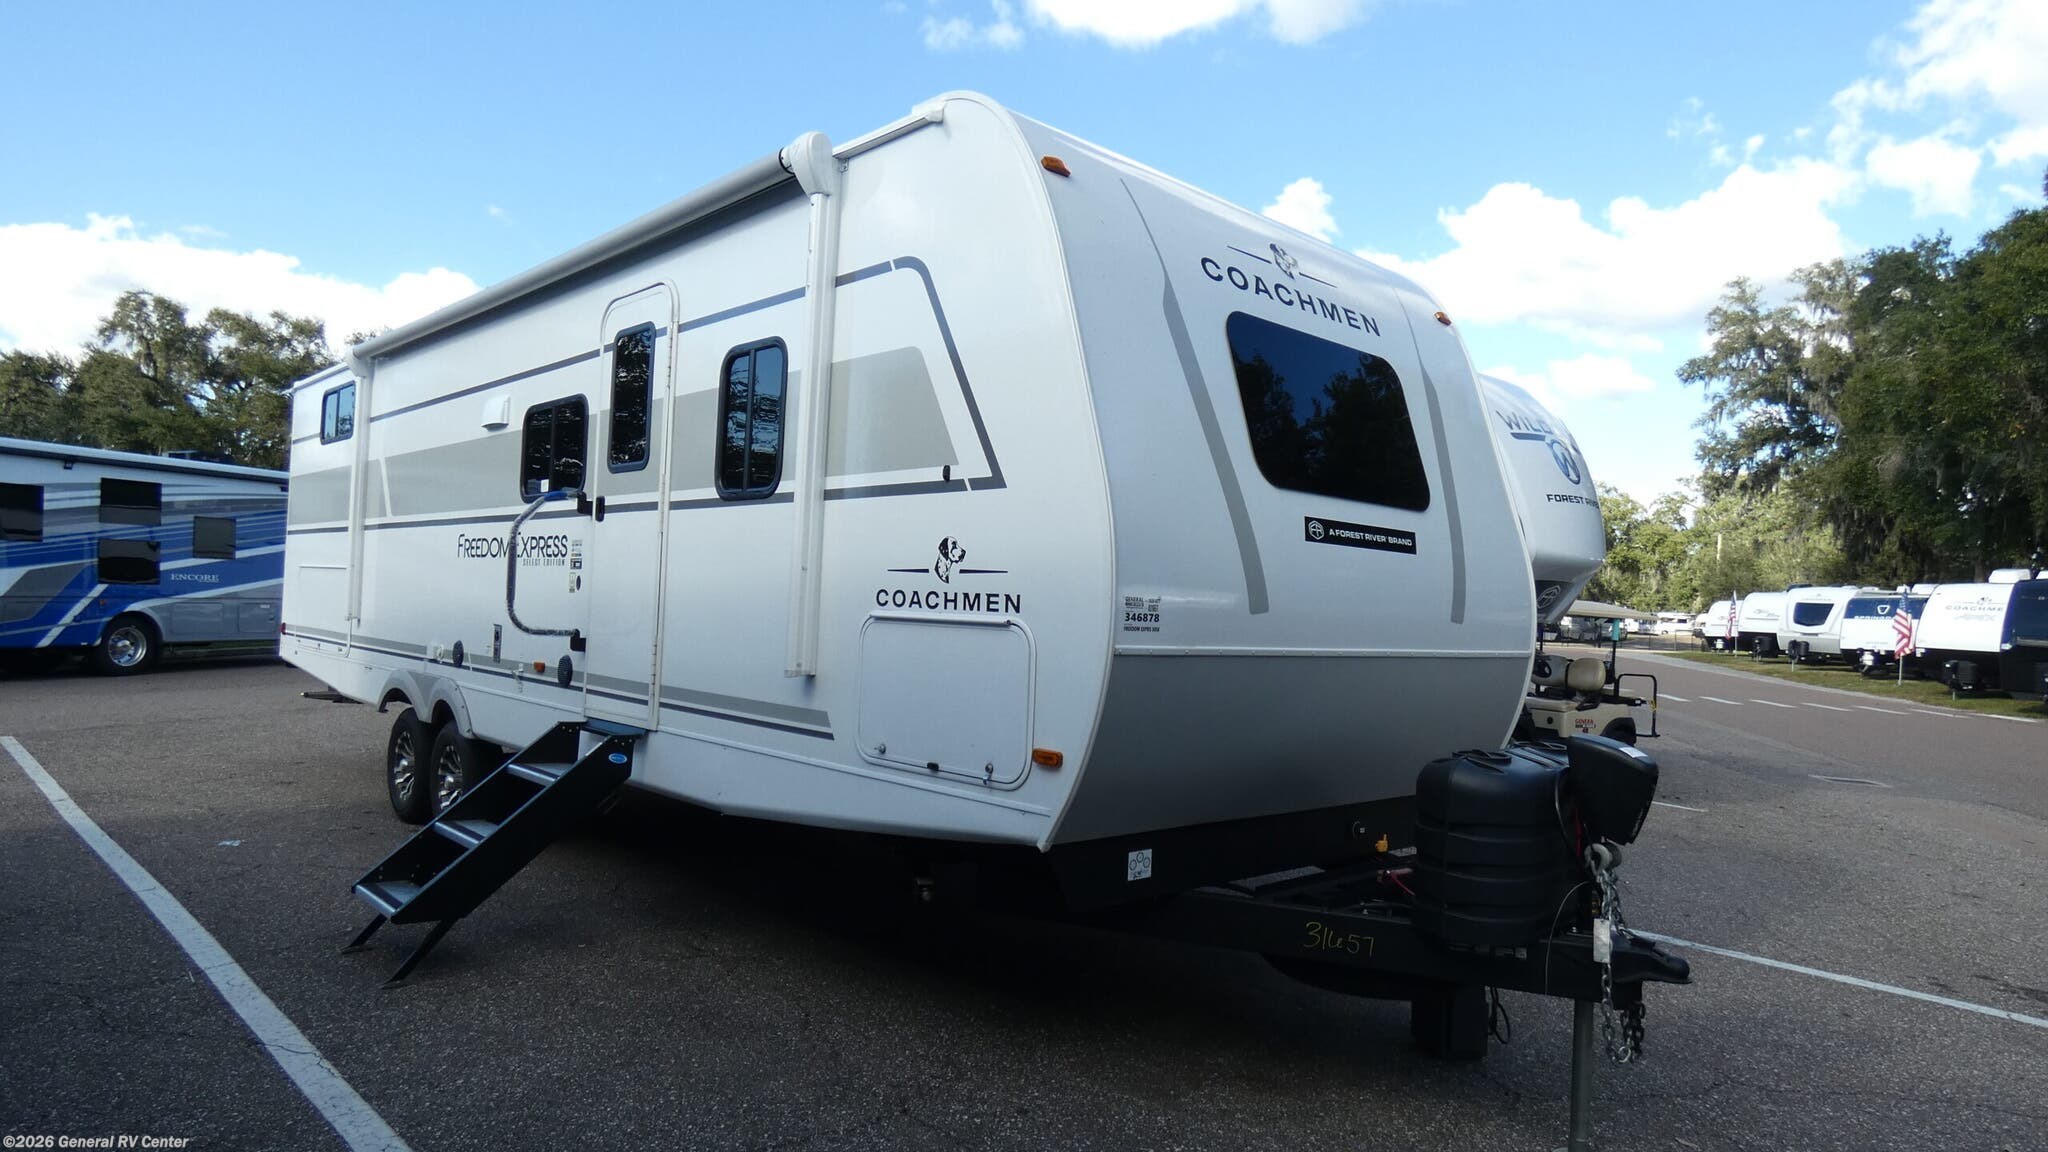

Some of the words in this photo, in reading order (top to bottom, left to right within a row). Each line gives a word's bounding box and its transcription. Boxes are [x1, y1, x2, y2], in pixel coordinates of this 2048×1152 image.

[1200, 256, 1381, 337] COACHMEN
[1546, 494, 1584, 504] FOREST
[1329, 528, 1335, 536] A
[1336, 529, 1364, 540] FOREST
[1365, 533, 1386, 543] RIVER
[1388, 536, 1412, 546] BRAND
[171, 573, 219, 582] ENCORE
[875, 588, 1021, 614] COACHMEN
[1124, 612, 1160, 622] 346878
[1304, 921, 1375, 957] 31657
